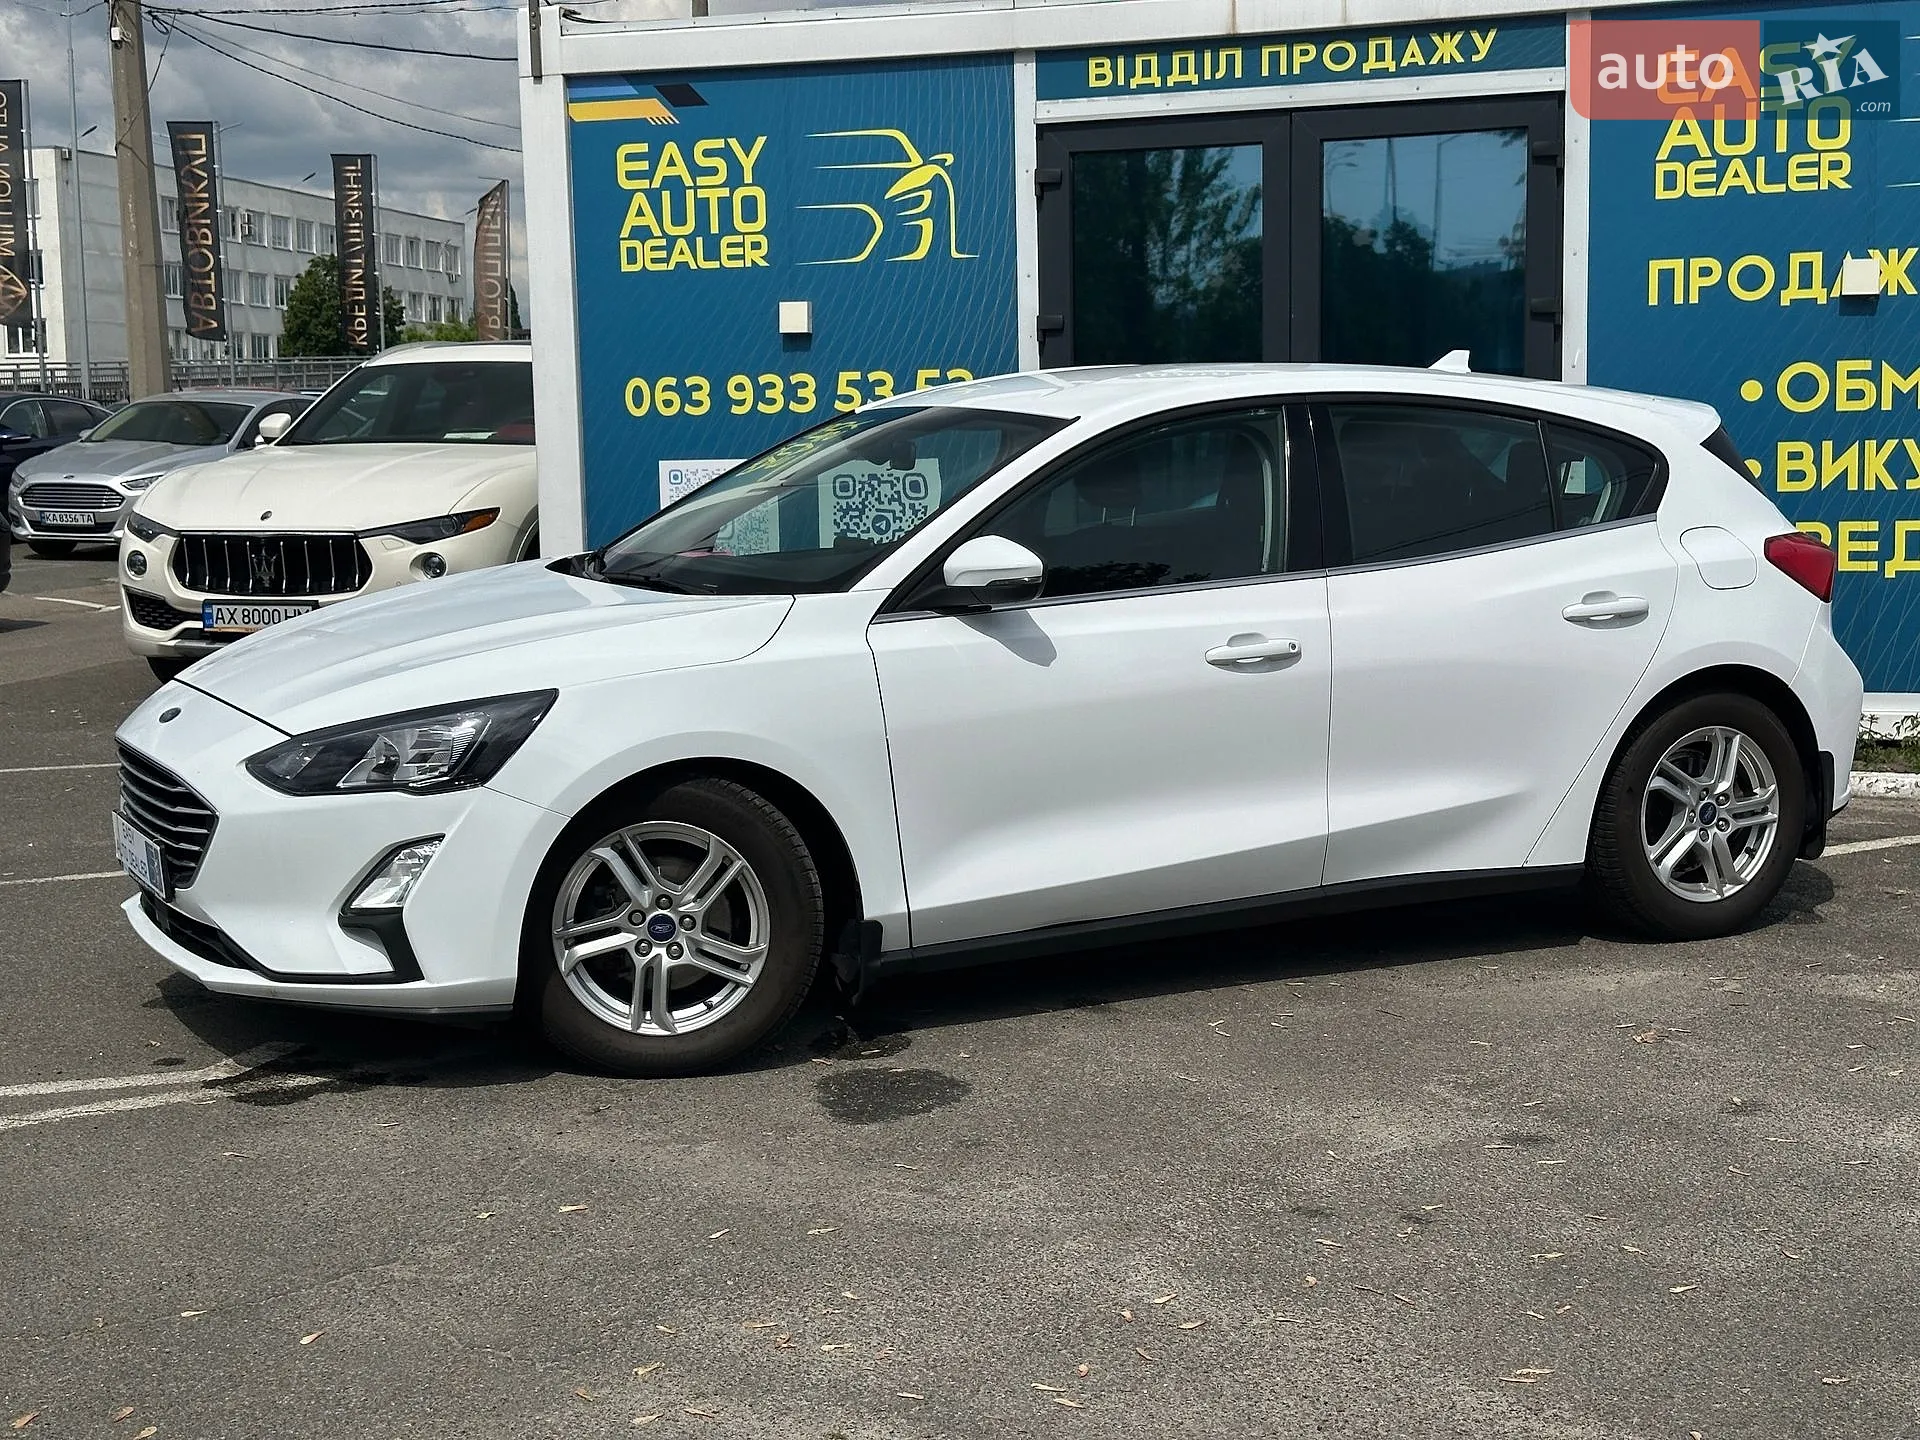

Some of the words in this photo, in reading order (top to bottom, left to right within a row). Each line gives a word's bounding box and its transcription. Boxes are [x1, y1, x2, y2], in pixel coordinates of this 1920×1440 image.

[1088, 47, 1243, 90] ВІДДІЛ
[1261, 28, 1498, 79] ПРОДАЖУ
[1656, 96, 1852, 161] AUTO
[616, 136, 768, 190] EASY
[1655, 151, 1852, 200] DEALER
[619, 186, 767, 239] AUTO
[620, 234, 770, 273] DEALER
[1648, 247, 1919, 307] ПРОДЖ
[624, 375, 710, 418] 063
[726, 372, 817, 416] 933
[834, 370, 894, 413] 53
[215, 607, 238, 625] AX
[242, 608, 282, 625] 8000
